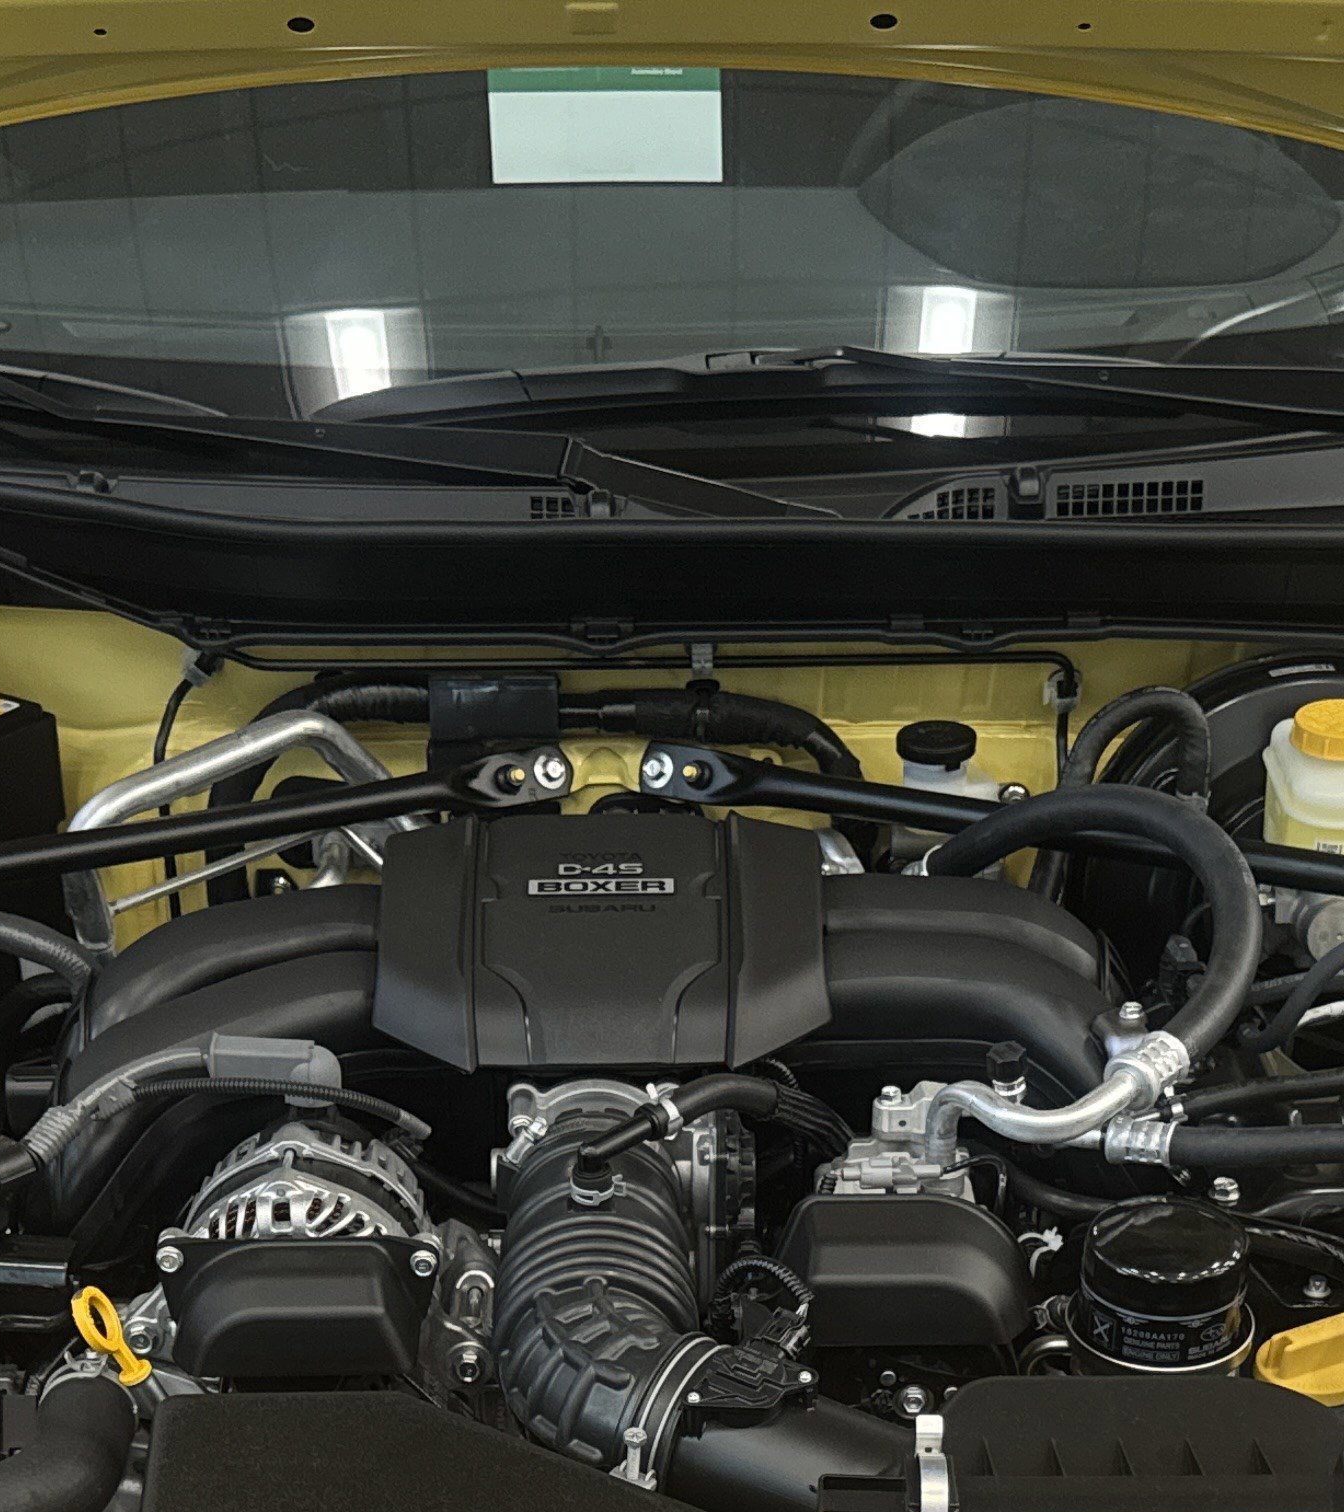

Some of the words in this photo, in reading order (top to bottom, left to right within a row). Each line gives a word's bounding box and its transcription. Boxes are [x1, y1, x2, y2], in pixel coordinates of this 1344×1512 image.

[559, 852, 641, 861] TOYOTA
[558, 863, 644, 876] D-4S
[537, 881, 666, 893] BOXER
[548, 904, 657, 914] SUBARU
